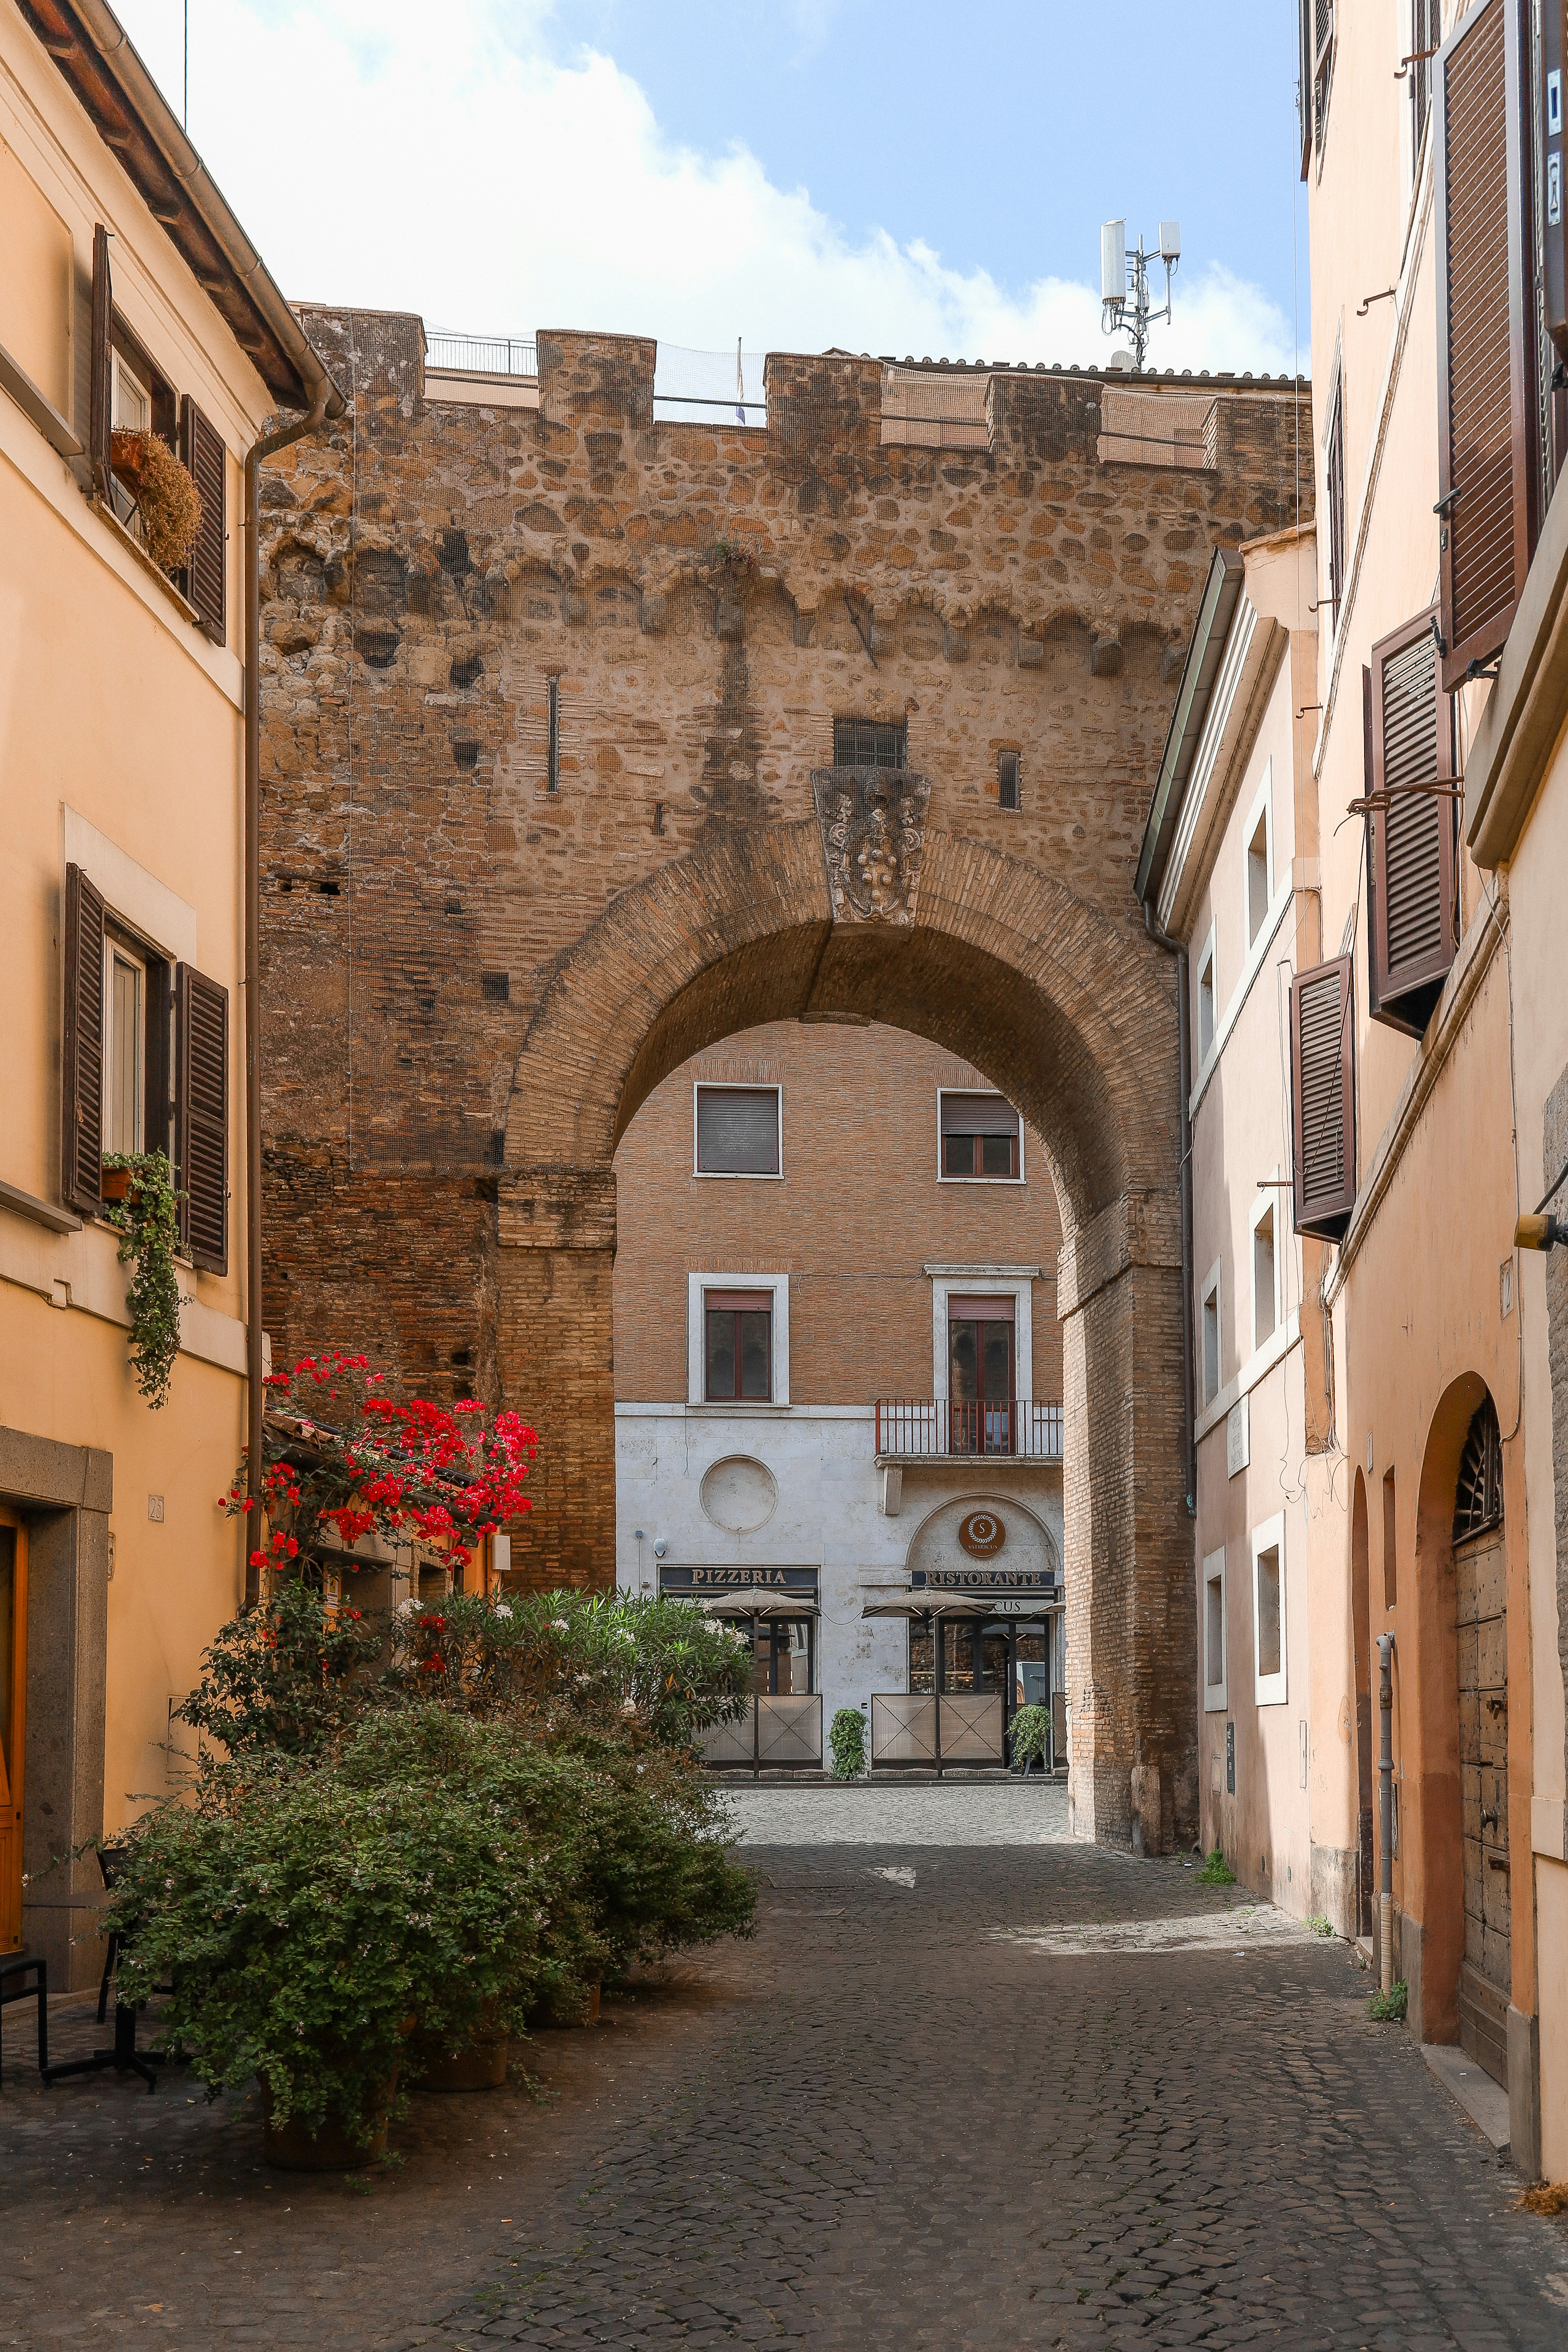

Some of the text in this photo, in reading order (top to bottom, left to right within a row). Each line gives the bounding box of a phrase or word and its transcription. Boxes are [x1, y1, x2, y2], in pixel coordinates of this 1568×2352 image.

[150, 1498, 161, 1519] 25
[979, 1523, 985, 1533] S
[692, 1569, 786, 1584] PIZZERIA
[924, 1571, 1041, 1585] RISTORANTE
[994, 1601, 1021, 1612] CUS
